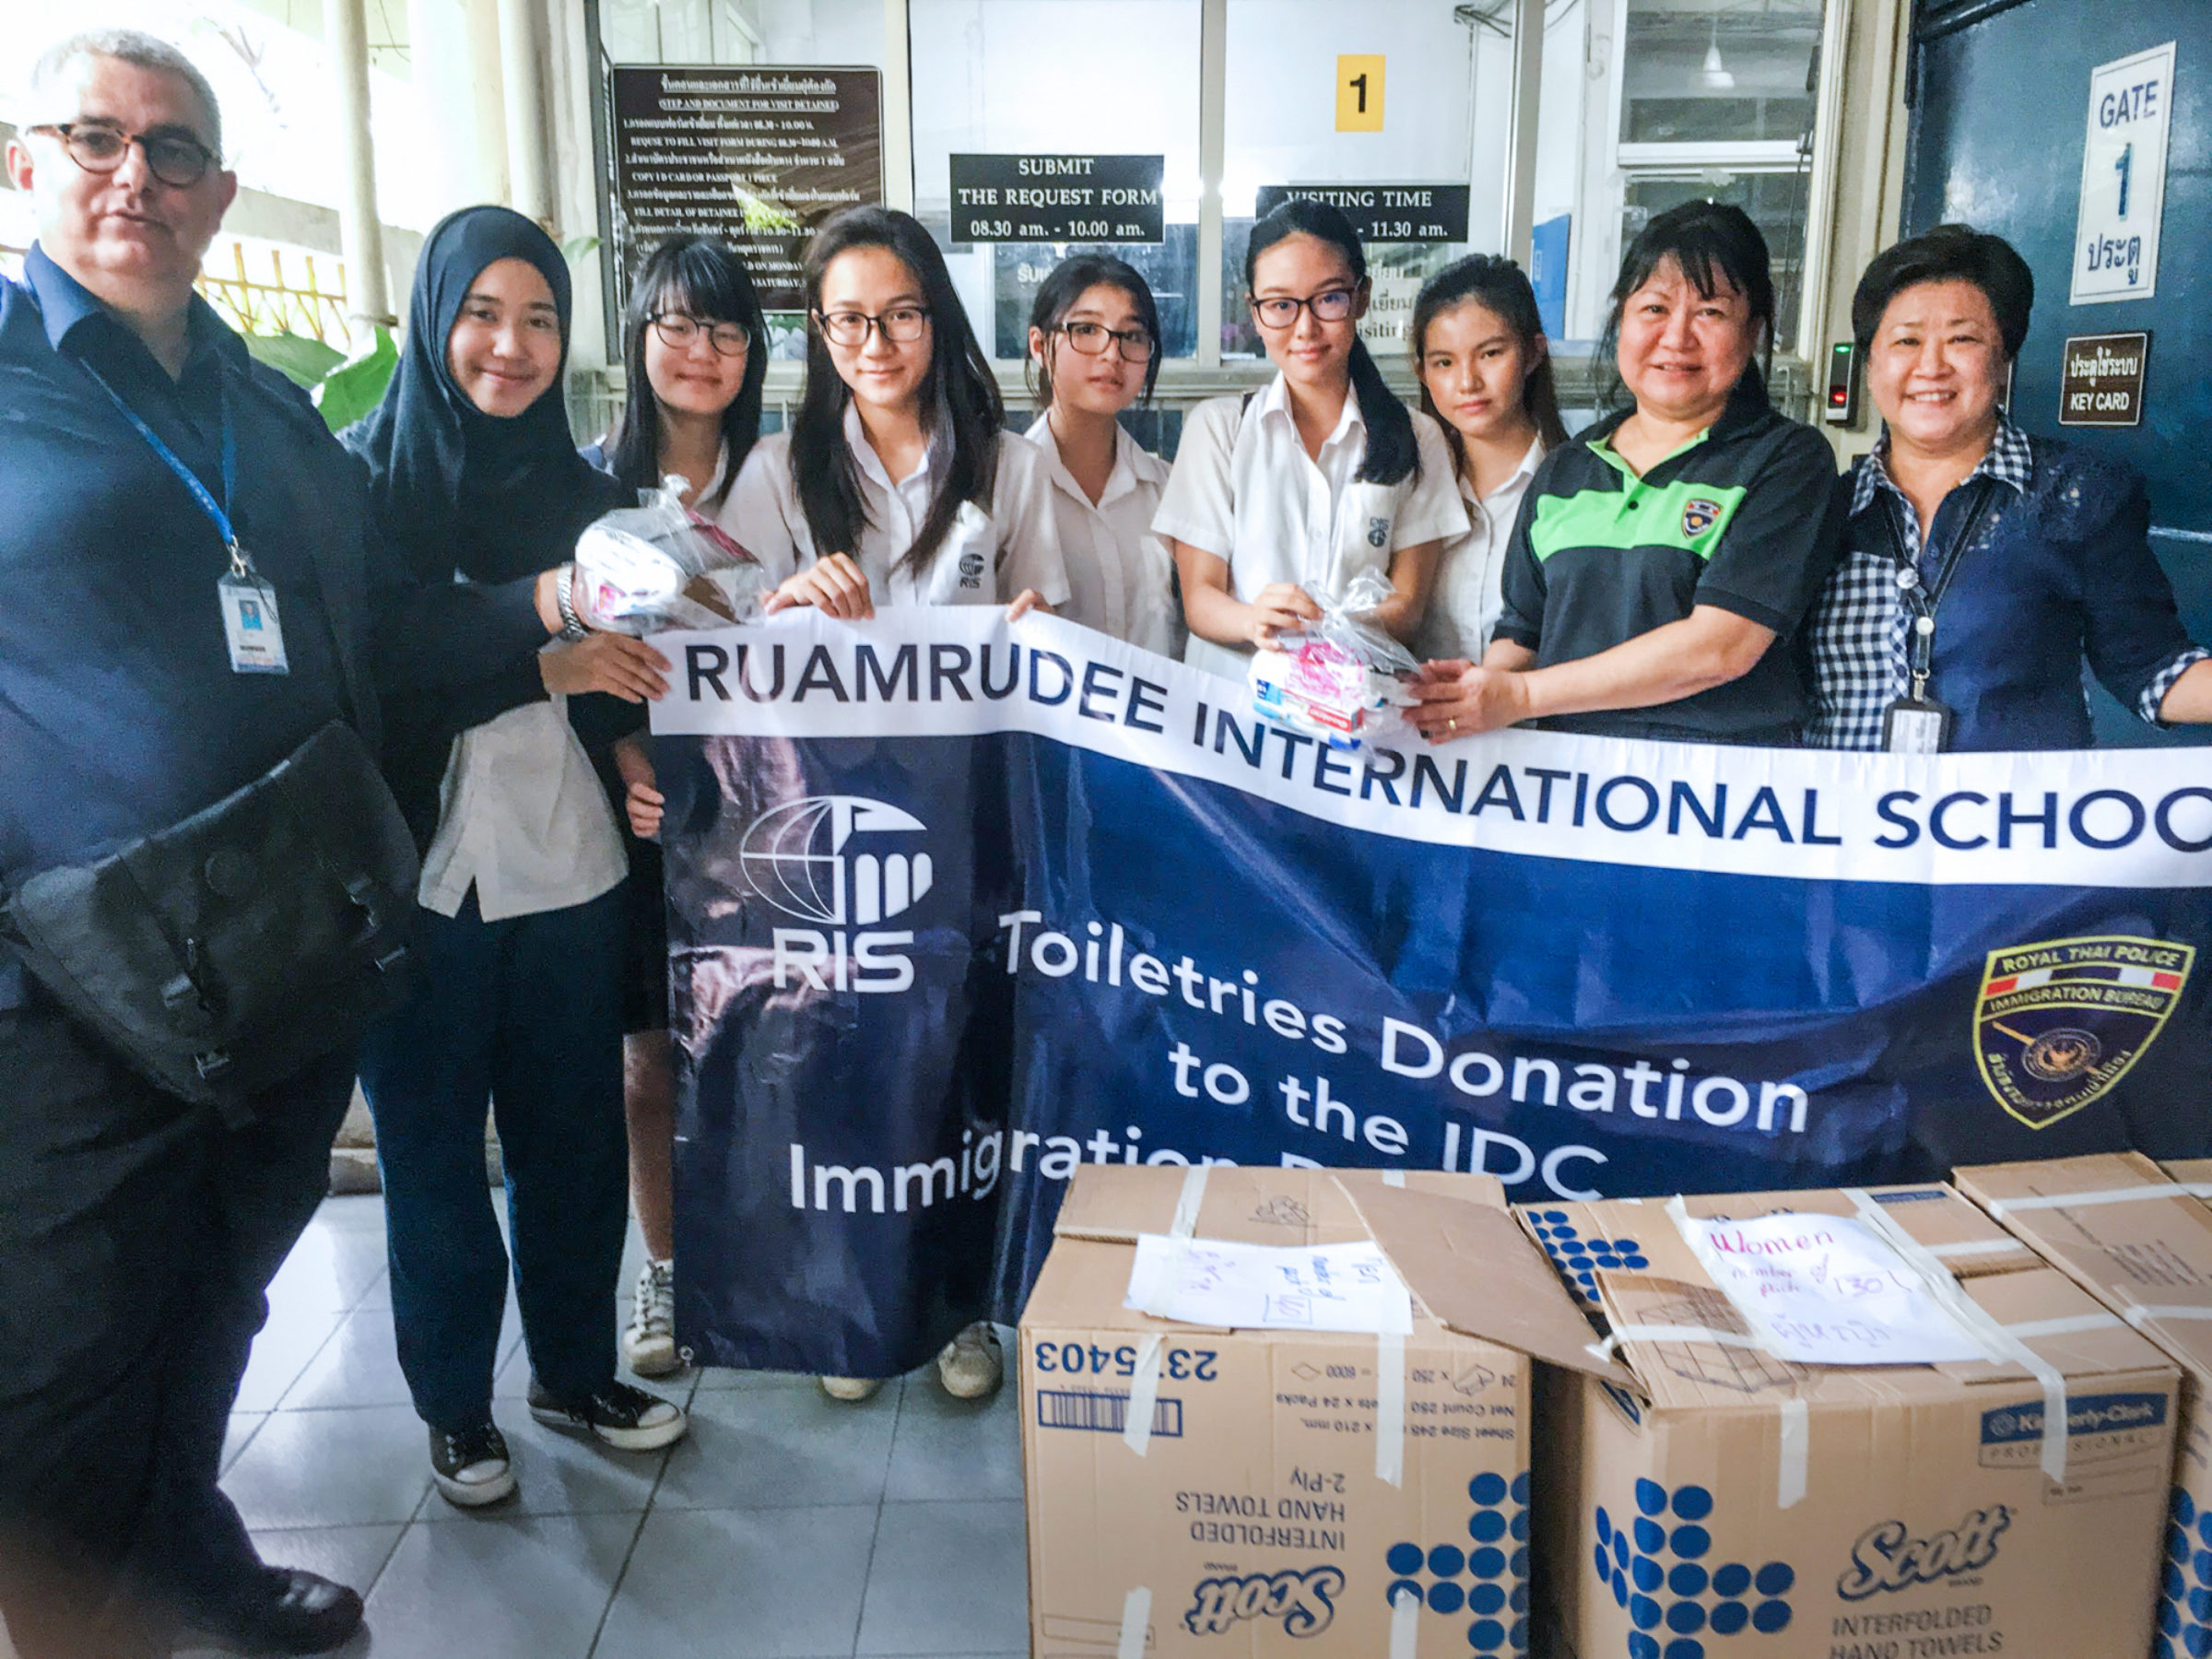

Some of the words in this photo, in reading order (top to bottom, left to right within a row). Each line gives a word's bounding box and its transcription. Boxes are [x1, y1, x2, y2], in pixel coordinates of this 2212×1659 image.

[1348, 73, 1368, 113] 1
[2100, 79, 2159, 129] GATE
[1018, 159, 1095, 175] SUBMIT
[2115, 142, 2132, 221] 1
[958, 188, 998, 206] THE
[1006, 188, 1094, 208] REQUEST
[1101, 189, 1158, 206] FORM
[1382, 191, 1432, 207] TIME
[971, 220, 1012, 237] 08.30
[1018, 223, 1050, 237] am.
[1068, 220, 1107, 237] 10.00
[1116, 223, 1146, 237] am.
[1371, 221, 1412, 237] 11.30
[1418, 224, 1449, 237] am.
[2088, 233, 2141, 285] ประตู
[2070, 392, 2095, 411] KEY
[2095, 392, 2130, 411] CARD
[684, 641, 1168, 735] RUAMRUDEE
[1194, 700, 1842, 846] INTERNATIONAL
[772, 927, 914, 993] RIS
[2001, 951, 2063, 973] ROYAL
[2067, 946, 2112, 961] THAI
[2114, 945, 2181, 967] POLICE
[1989, 987, 2102, 1012] IMMIGRATION
[998, 910, 1347, 1054] Toiletries
[1381, 1015, 1808, 1133] Donation
[1168, 1041, 1251, 1105] to
[1278, 1075, 1408, 1156] the
[1442, 1121, 1609, 1202] IDC
[1710, 1230, 1834, 1255] Women
[1035, 1342, 1218, 1382] 235403
[1276, 1394, 1317, 1408] Packs
[1441, 1404, 1486, 1418] Count
[1489, 1406, 1515, 1418] Net
[1441, 1427, 1471, 1440] Size
[1475, 1428, 1515, 1441] Sheet
[1290, 1465, 1346, 1493] 2-Ply
[1175, 1491, 1272, 1519] TOWELS
[1277, 1499, 1346, 1523] HAND
[1190, 1521, 1346, 1551] INTERFOLDED
[1837, 1504, 2011, 1602] Scott
[1184, 1564, 1346, 1639] Scott
[1831, 1604, 1993, 1637] INTERFOLDED
[1830, 1641, 1900, 1659] HAND
[1906, 1630, 2005, 1658] TOWELS
